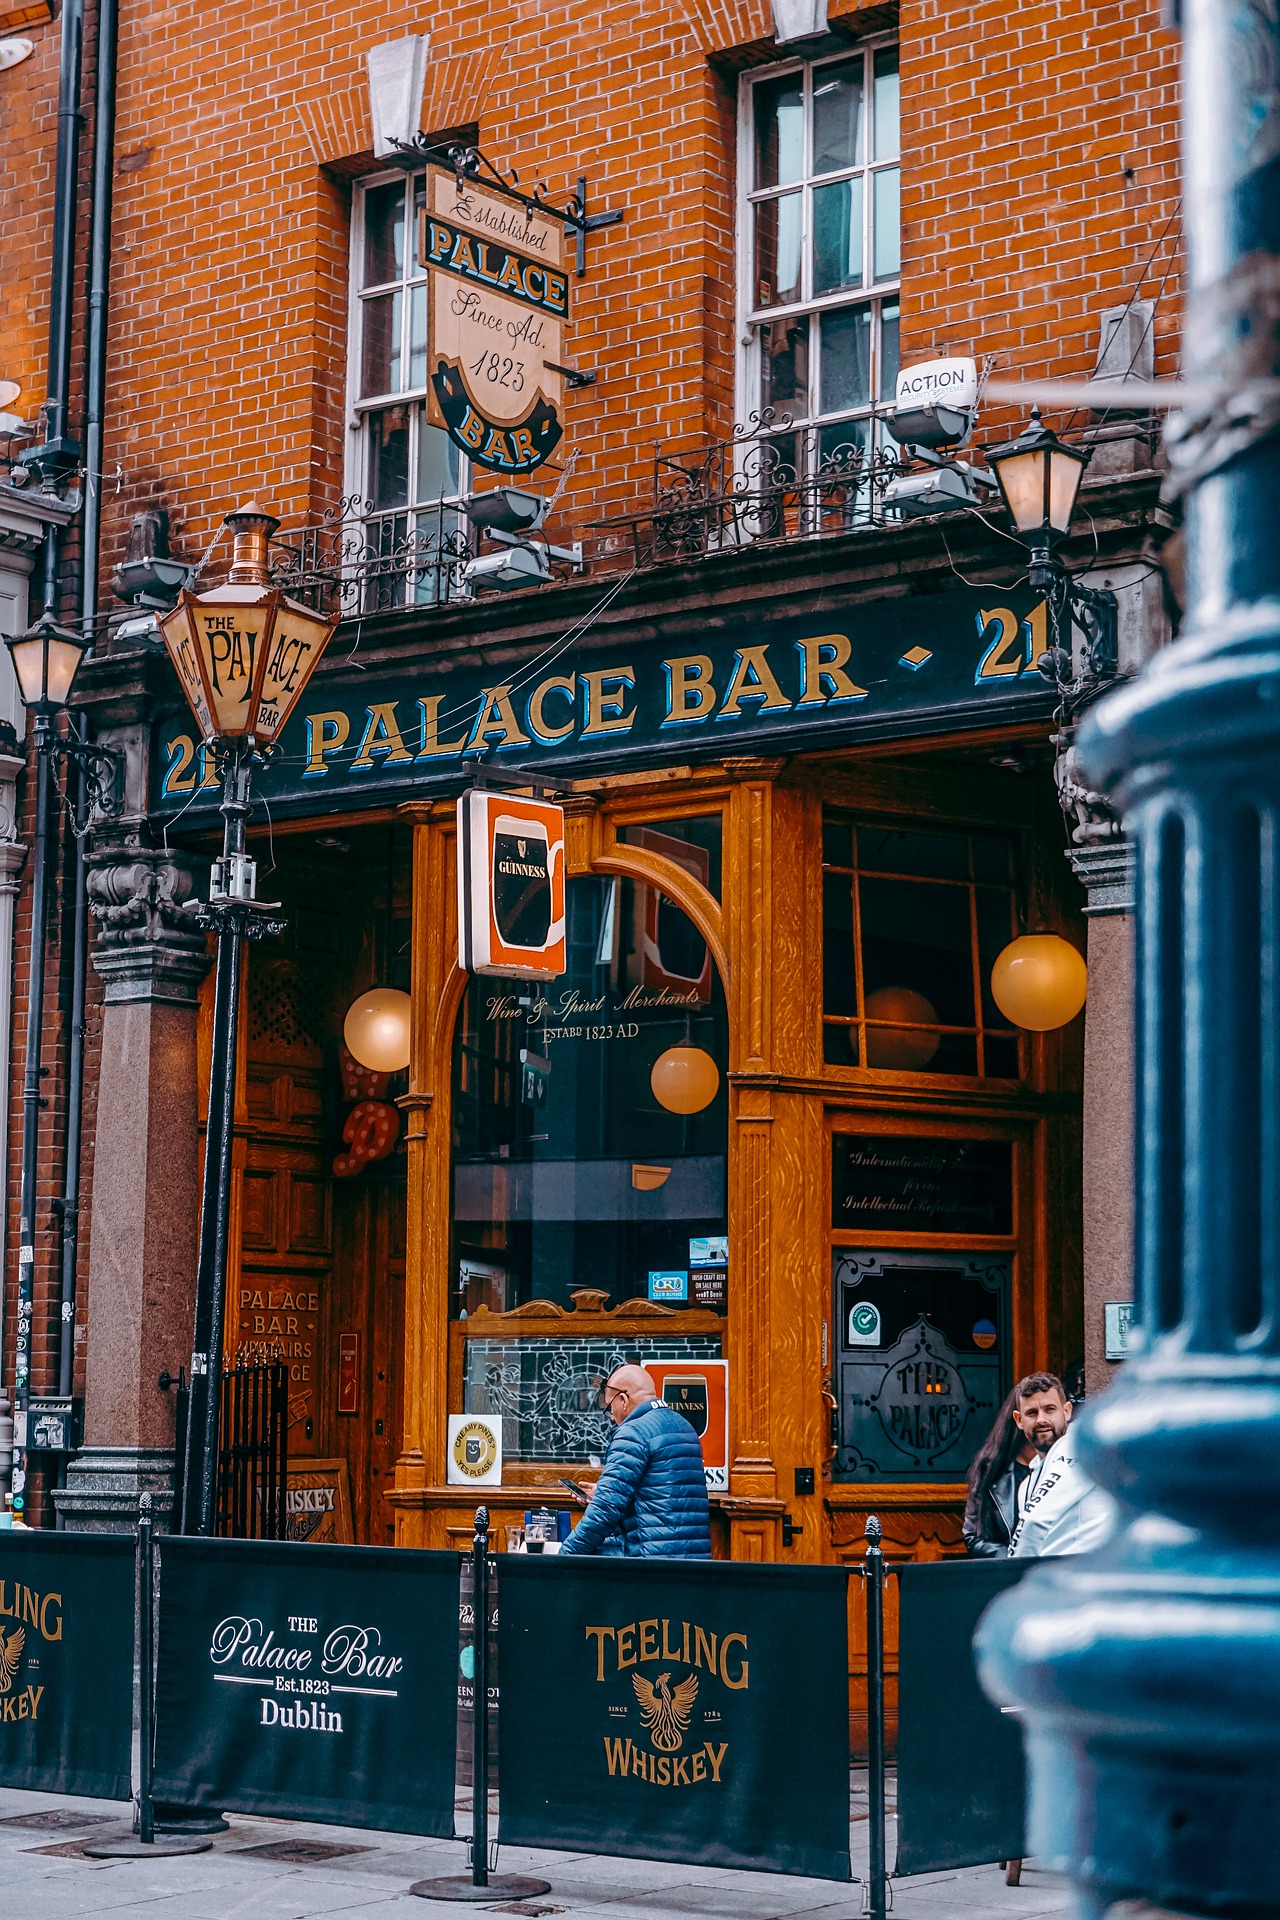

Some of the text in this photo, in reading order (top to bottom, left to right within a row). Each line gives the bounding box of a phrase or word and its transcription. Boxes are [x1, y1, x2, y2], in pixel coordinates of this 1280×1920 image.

[449, 195, 548, 251] Established
[429, 223, 566, 312] PALACE
[451, 289, 503, 332] Since
[470, 350, 525, 392] 1823
[900, 369, 964, 395] ACTION
[900, 385, 965, 403] SECURITY SYSTEMS
[454, 404, 541, 468] BAR
[204, 617, 235, 630] THE
[974, 600, 1047, 686] 21
[258, 706, 280, 729] BAR
[301, 665, 638, 780] PALACE
[659, 633, 869, 730] BAR
[499, 861, 546, 879] GUINNESS
[486, 985, 700, 1024] Wine & Spirit Merchants
[585, 1025, 614, 1040] 1823
[616, 1023, 639, 1038] AD
[842, 1195, 914, 1210] Intellectual
[240, 1290, 319, 1311] PALACE
[252, 1315, 300, 1336] BAR
[896, 1362, 951, 1396] THE
[455, 1422, 478, 1448] CREAMY
[889, 1404, 960, 1448] PALACE
[470, 1458, 493, 1477] PLEASE
[256, 1486, 337, 1513] ISKEY
[1024, 1472, 1062, 1513] FRESH
[0, 1580, 63, 1641] LING
[287, 1616, 318, 1633] THE
[210, 1616, 403, 1678] Palace Bar
[585, 1619, 749, 1690] TEELING
[275, 1675, 330, 1695] Est.1823
[260, 1697, 344, 1732] Dublin
[704, 1710, 722, 1718] 1782
[603, 1737, 729, 1786] WHISKEY
